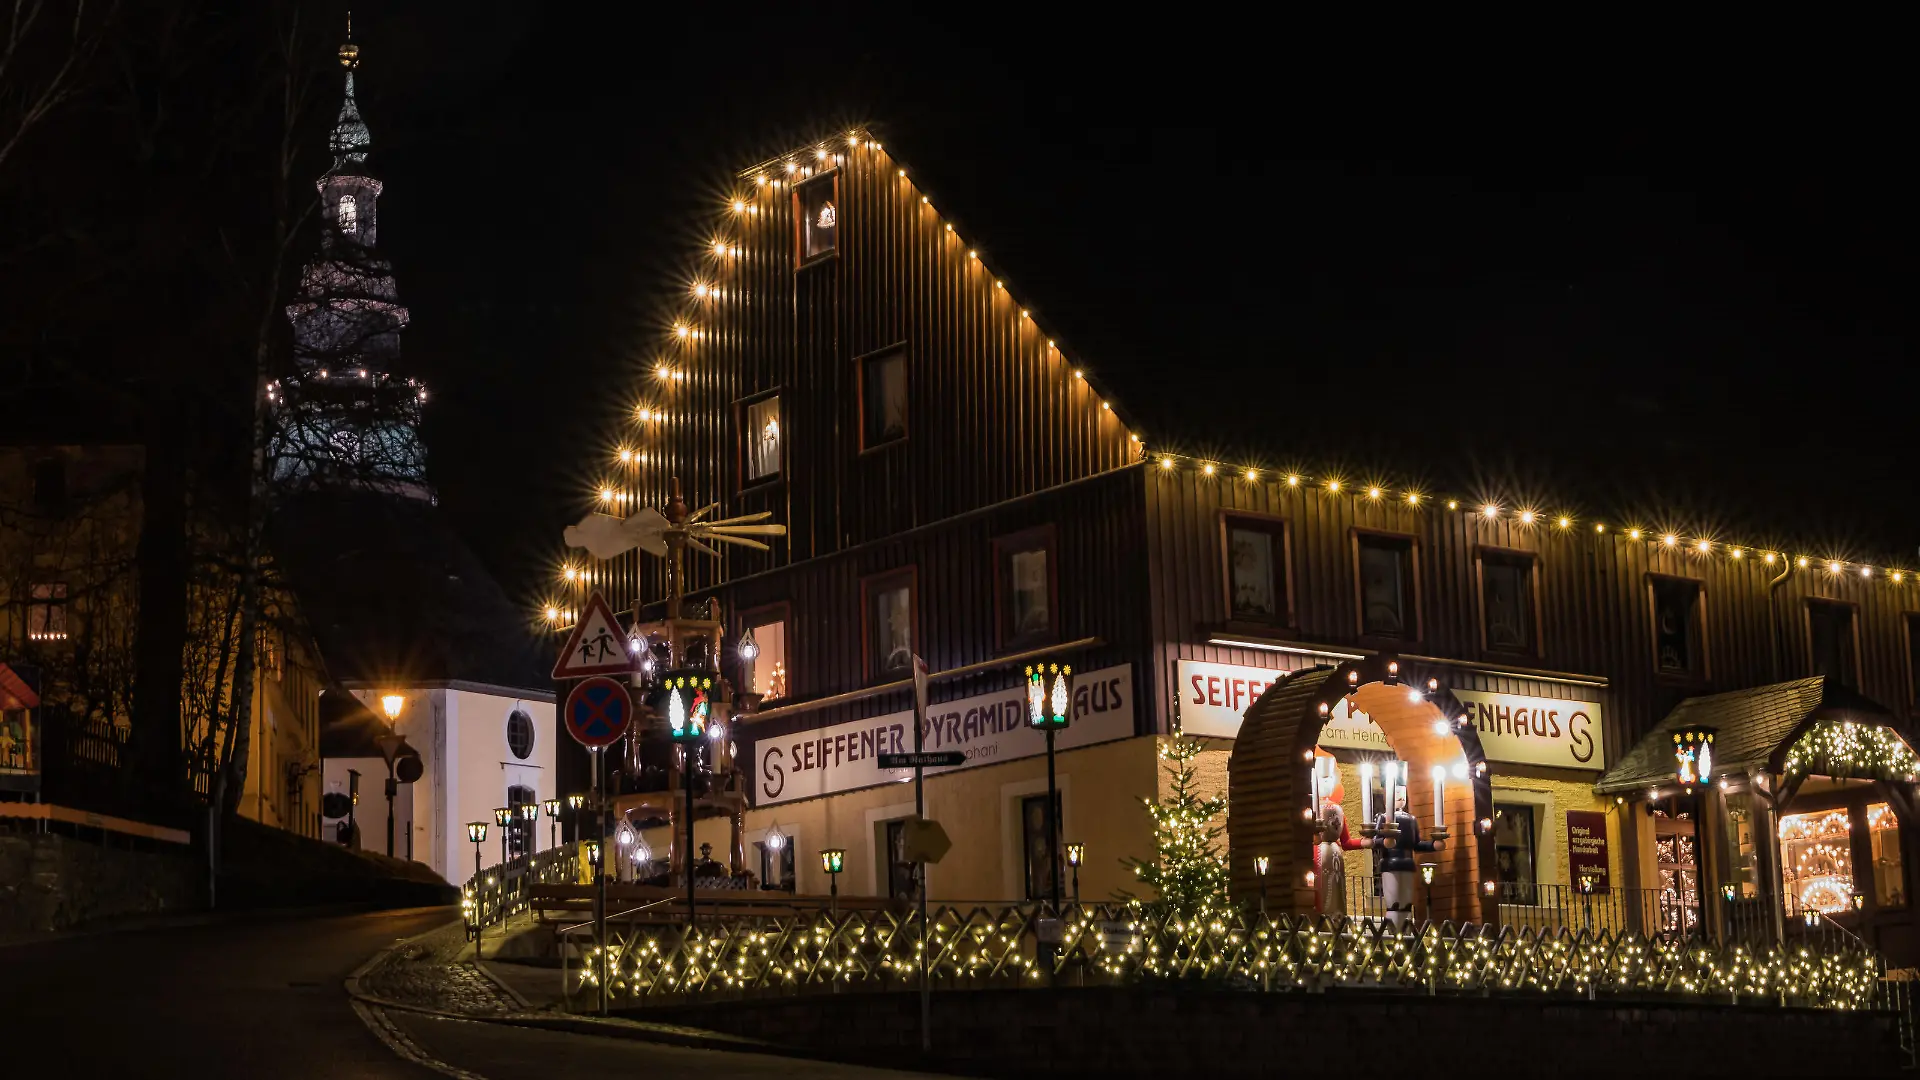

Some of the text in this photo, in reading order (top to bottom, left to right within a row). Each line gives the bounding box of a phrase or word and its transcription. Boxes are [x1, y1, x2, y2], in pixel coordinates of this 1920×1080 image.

[791, 723, 906, 772] SEIFFENER
[920, 677, 1123, 751] PYRAMIDAUS
[1191, 674, 1275, 712] SEIFF
